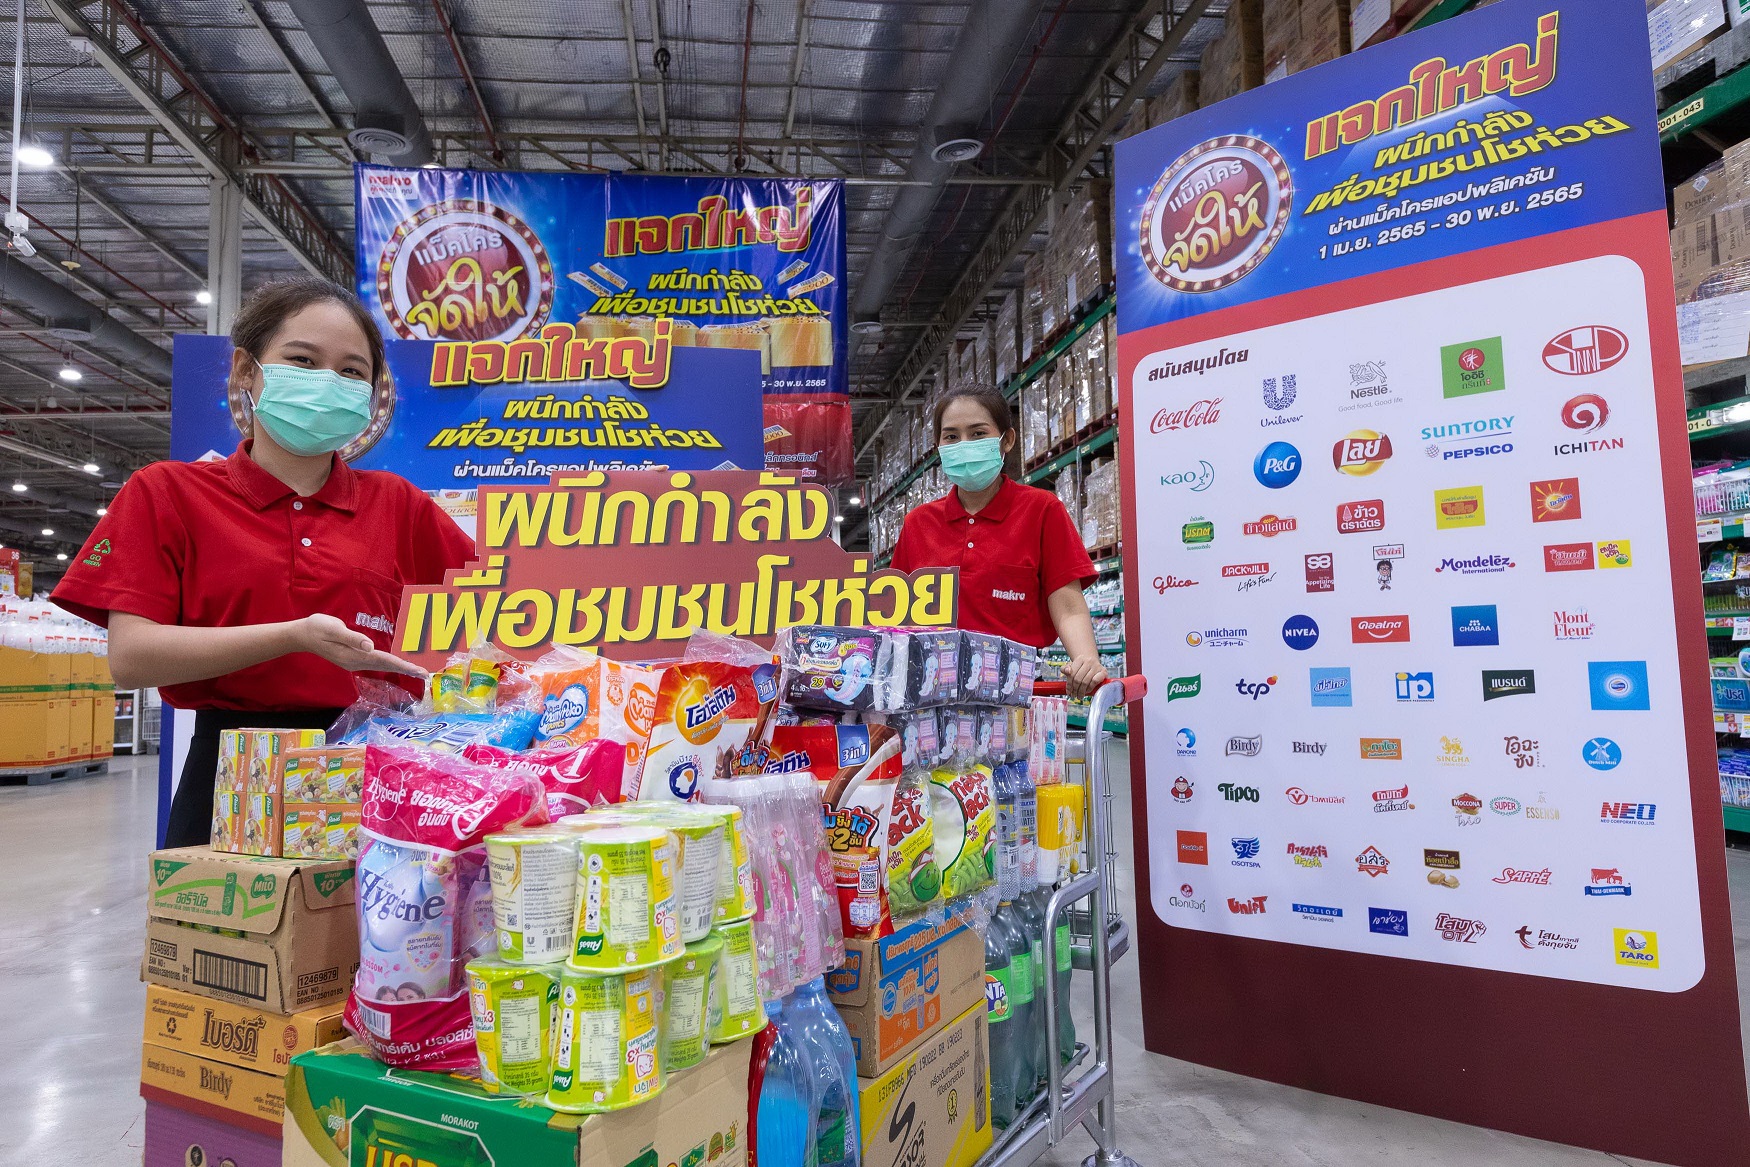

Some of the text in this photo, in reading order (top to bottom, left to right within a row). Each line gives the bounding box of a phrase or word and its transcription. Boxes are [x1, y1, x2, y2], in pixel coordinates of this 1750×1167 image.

[1304, 10, 1559, 161] แจกใหญ่
[1683, 101, 1701, 116] 043
[1374, 110, 1533, 169] ผนึกกำลัง
[1303, 115, 1630, 215] เพื่อชุมชนโชห่วย
[1168, 160, 1243, 213] แม็คโคร
[1329, 166, 1555, 236] ผ่านแม็คโครแอปพลิเคชัน
[604, 187, 813, 258] แจกใหญ่
[1163, 181, 1267, 272] จัดให้
[1319, 245, 1327, 260] 1
[1332, 231, 1372, 257] เม.ย.
[1377, 221, 1427, 245] 2565
[1445, 211, 1472, 231] 30
[1477, 198, 1520, 224] พ.ย.
[1525, 183, 1584, 210] 2565
[414, 231, 504, 267] แม็คโคร
[648, 267, 763, 291] ผนึกกำลัง
[405, 256, 528, 338] จัดให้
[588, 289, 821, 318] เพื่อชุมชนโชห่วย
[429, 318, 673, 389] แจกใหญ่
[774, 380, 784, 388] 30
[805, 379, 826, 387] 2565
[504, 394, 649, 420] ผนึกกำลัง
[1338, 404, 1354, 413] Good
[1374, 399, 1391, 408] Good
[1392, 397, 1404, 405] life
[1150, 397, 1225, 435] Coca-Cola
[1260, 414, 1304, 428] Unilever
[428, 418, 722, 453] เพื่อชุมชนโชห่วย
[1421, 415, 1516, 440] SUNTORY
[1341, 431, 1382, 466] เลย์
[1443, 443, 1514, 461] PEPSICO
[1554, 437, 1625, 456] ICHITAN
[1263, 455, 1297, 475] P&G
[486, 470, 830, 548] ผนึกกำลัง
[1354, 505, 1379, 519] ข้าว
[1340, 518, 1381, 531] ตราฉัตร
[1462, 566, 1505, 575] International
[992, 588, 1026, 601] makro
[1153, 576, 1199, 595] Glico
[401, 555, 955, 656] เพื่อชุมชนโชห่วย
[1358, 619, 1403, 631] คอลเกต
[1554, 611, 1589, 625] Mont
[1204, 628, 1248, 638] unicharm
[1285, 628, 1317, 637] NIVEA
[1459, 625, 1492, 633] CHABAA
[1554, 623, 1592, 637] Fleur
[815, 641, 831, 650] SOFY
[811, 676, 825, 688] 29
[1235, 678, 1270, 701] tcp
[1491, 676, 1527, 689] แบรนด์
[686, 684, 736, 728] โอวัลติน
[1230, 739, 1260, 752] Birdy
[1292, 741, 1326, 756] Birdy
[1436, 755, 1471, 764] SINGHA
[367, 777, 407, 804] Hygiene
[1217, 783, 1260, 803] Tipco
[1453, 800, 1481, 808] MOCCONA
[1494, 801, 1516, 811] SUPER
[1601, 802, 1657, 821] NEO
[1231, 860, 1261, 869] OSOTSPA
[253, 881, 274, 892] MILO
[360, 868, 446, 923] Hygiene
[1619, 951, 1654, 961] TARO
[299, 968, 338, 987] 12469879
[200, 1065, 233, 1100] Birdy
[440, 1113, 480, 1131] MORAKOT
